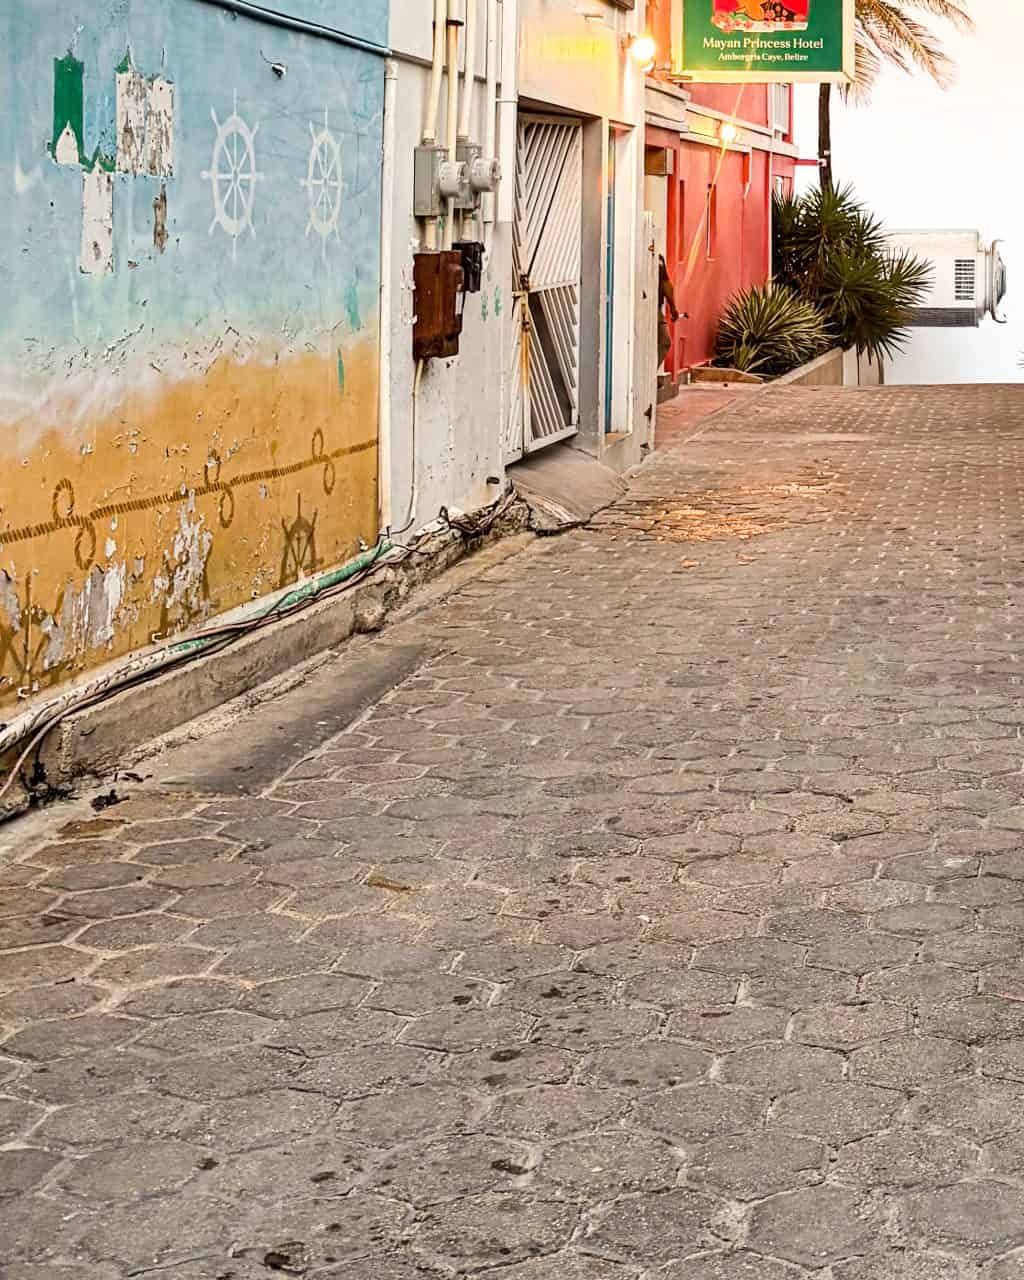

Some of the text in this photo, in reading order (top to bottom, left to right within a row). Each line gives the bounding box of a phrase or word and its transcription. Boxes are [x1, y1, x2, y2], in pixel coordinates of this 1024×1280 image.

[703, 37, 824, 51] Mayan Princess Hotel
[718, 53, 761, 62] Ambergris
[784, 53, 809, 62] Belize
